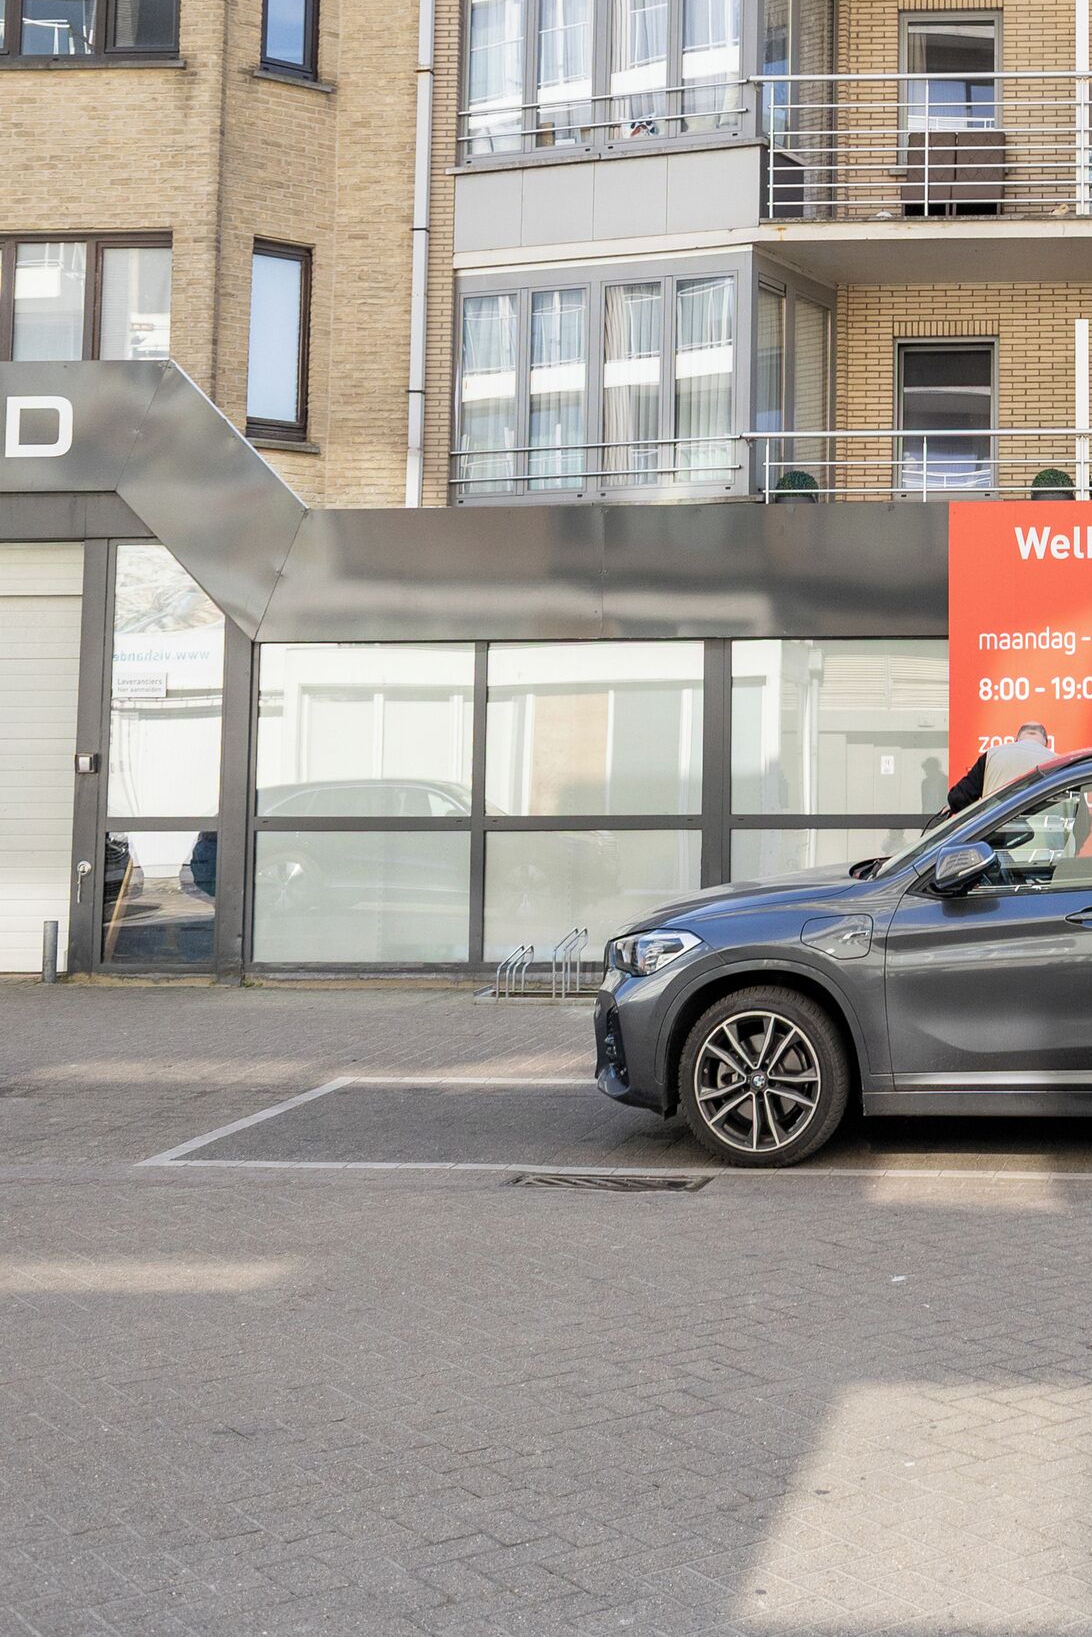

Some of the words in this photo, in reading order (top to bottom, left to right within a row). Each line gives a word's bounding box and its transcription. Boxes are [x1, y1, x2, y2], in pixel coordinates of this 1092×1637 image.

[5, 395, 74, 458] D
[978, 626, 1076, 655] maandag
[978, 677, 1030, 701] 8:00
